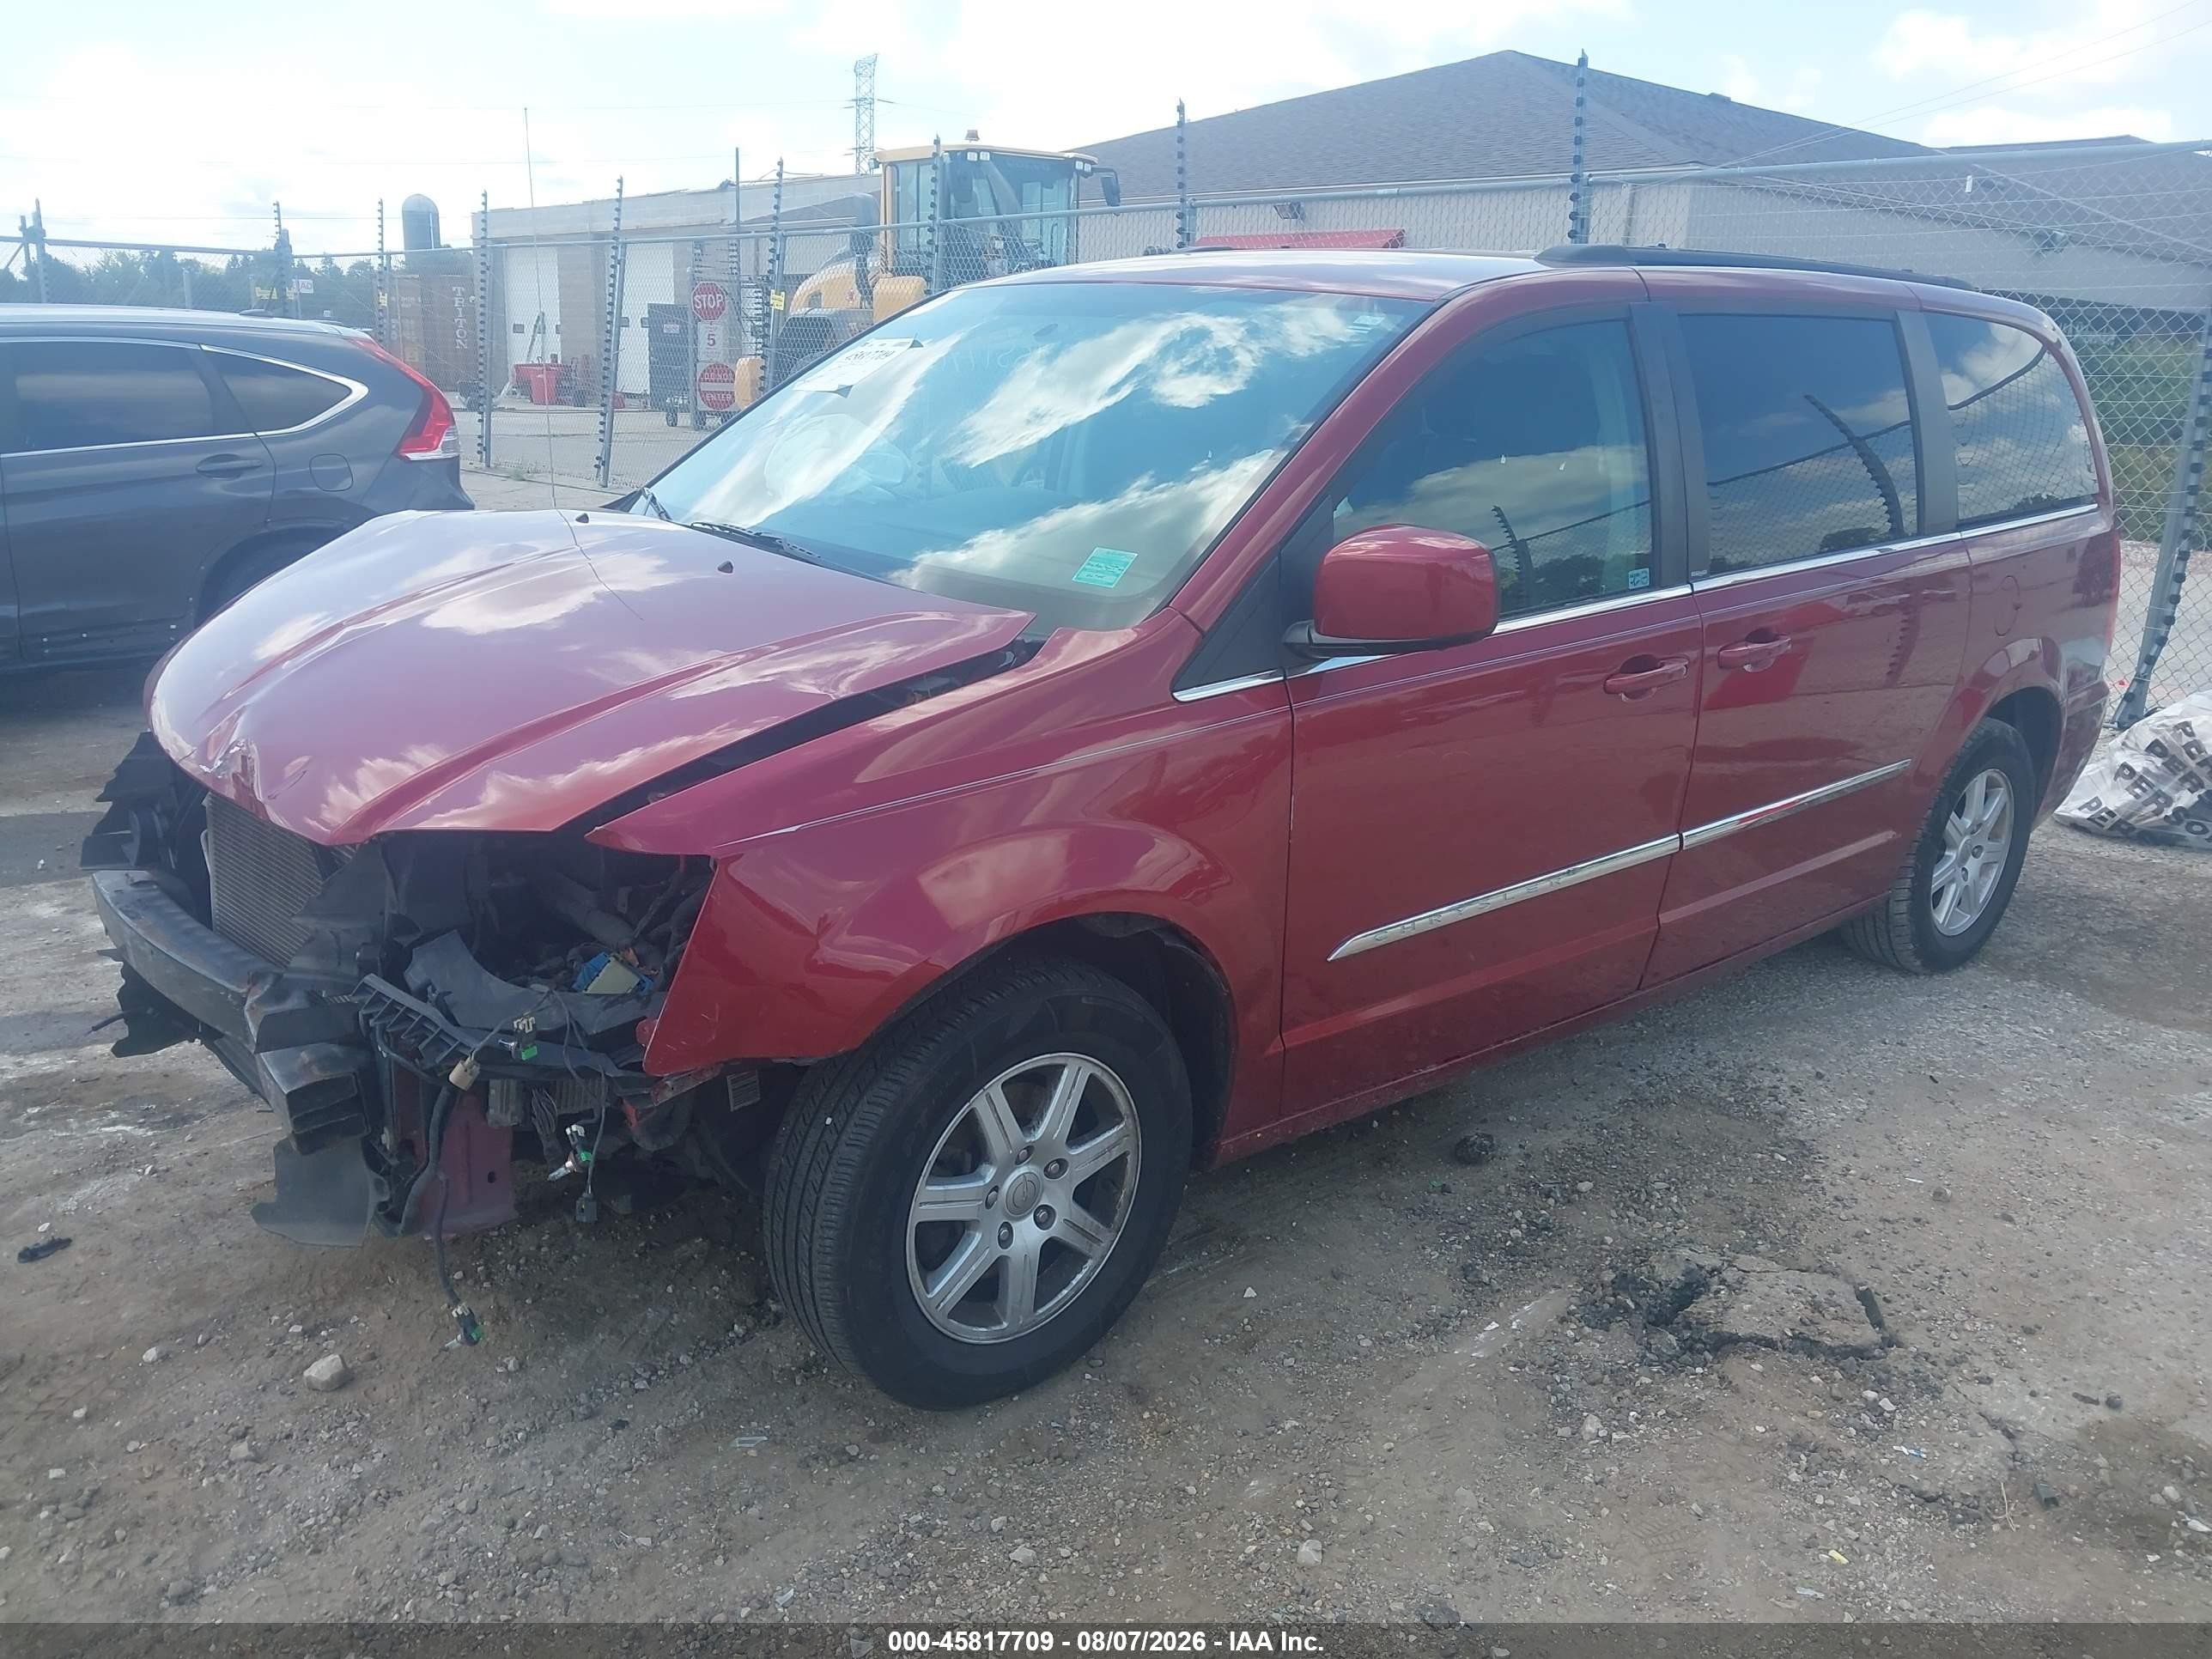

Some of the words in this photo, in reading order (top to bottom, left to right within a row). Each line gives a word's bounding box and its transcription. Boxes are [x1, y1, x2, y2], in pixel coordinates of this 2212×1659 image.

[453, 286, 468, 349] TRITON
[694, 295, 723, 309] STOP
[707, 333, 716, 347] 5
[2113, 761, 2212, 842] PERSO
